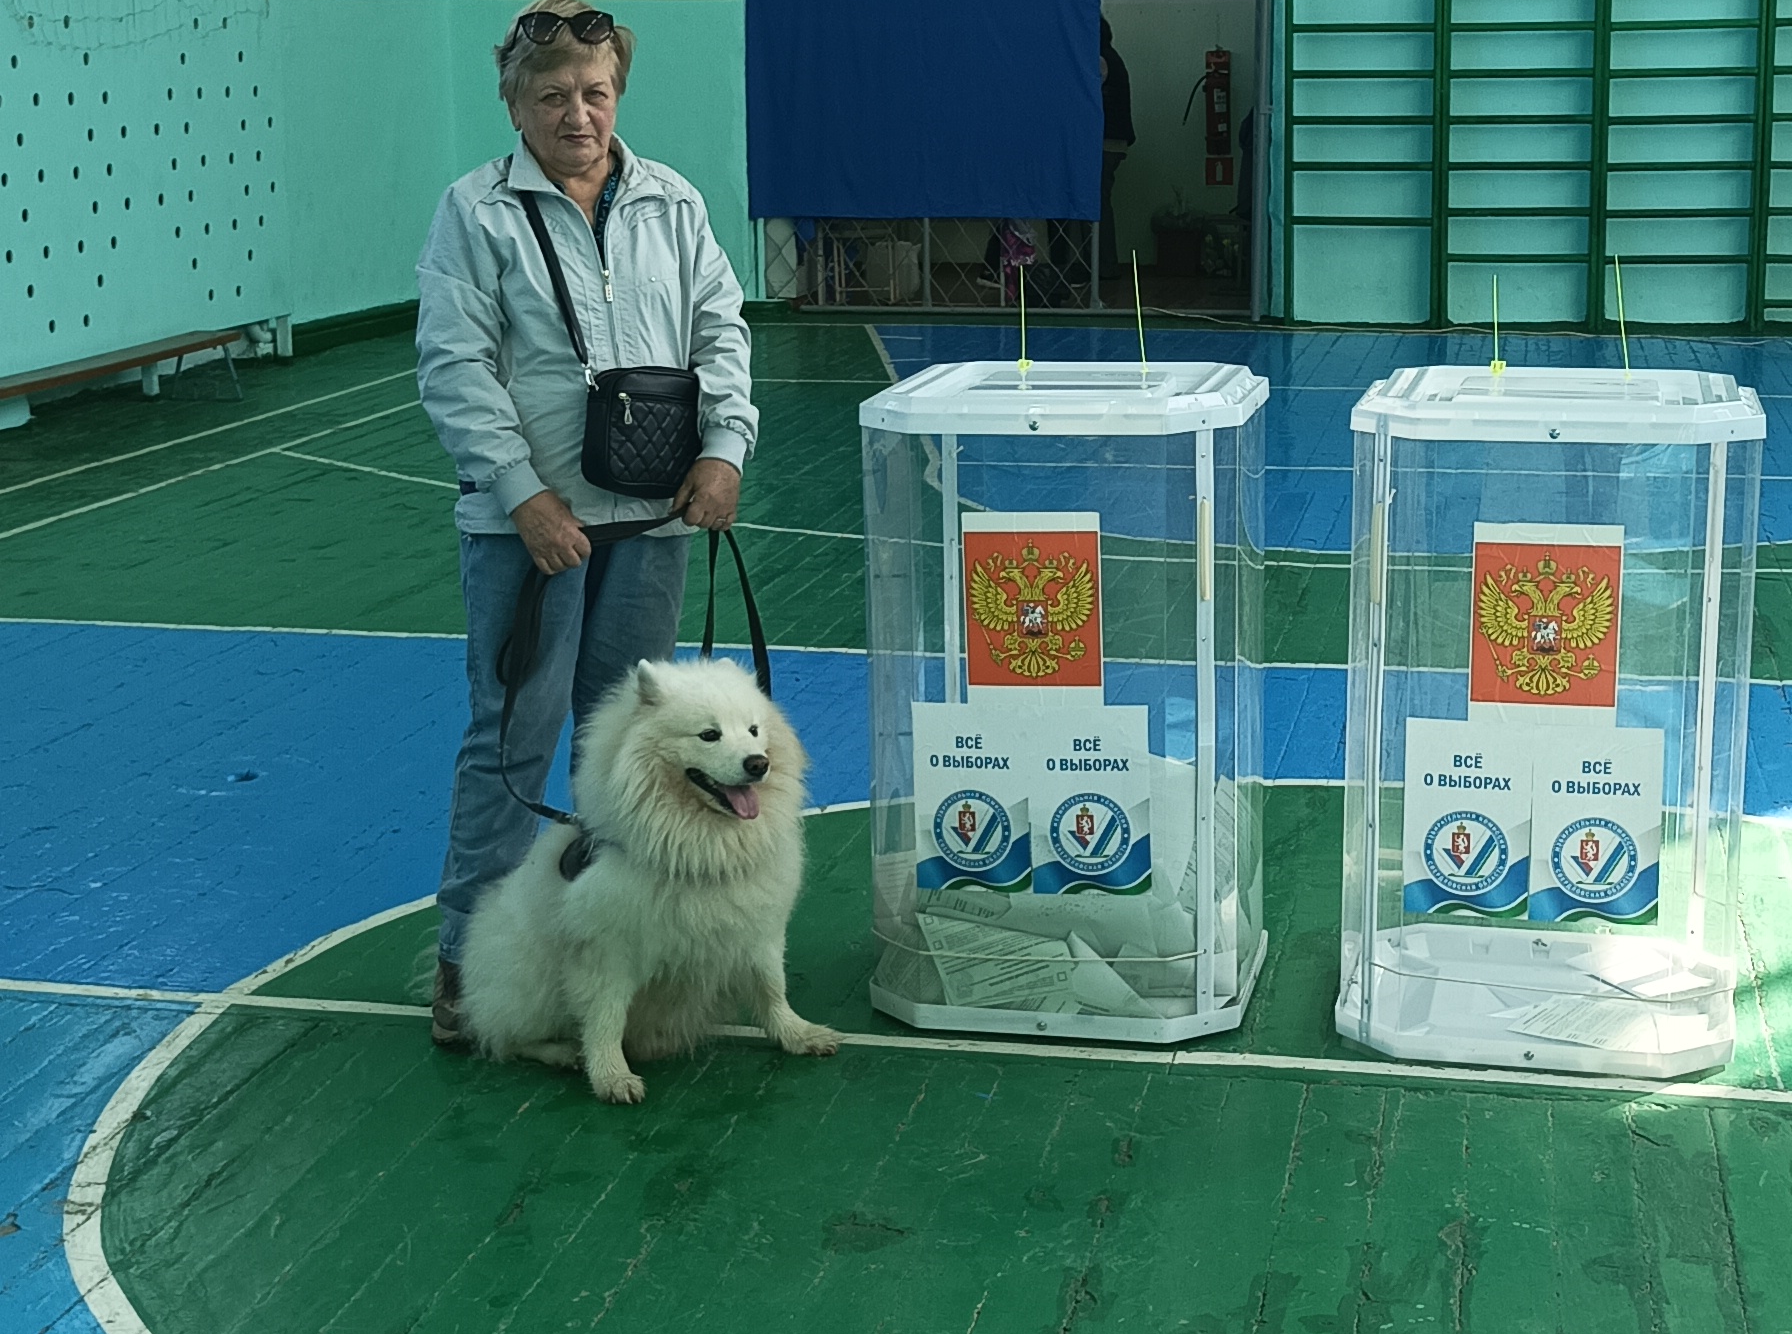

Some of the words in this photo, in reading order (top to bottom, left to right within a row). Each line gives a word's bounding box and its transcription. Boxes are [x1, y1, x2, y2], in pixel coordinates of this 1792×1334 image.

[955, 733, 983, 749] ВСЁ
[1073, 736, 1101, 752] ВСЁ
[930, 755, 939, 768] О
[942, 755, 1010, 770] ВЫБОРАХ
[1046, 758, 1056, 771] О
[1059, 758, 1130, 772] ВЫБОРАХ
[1453, 752, 1483, 769] ВСЁ
[1581, 758, 1612, 775] ВСЁ
[1423, 773, 1433, 786] О
[1437, 774, 1512, 791] ВЫБОРАХ
[1551, 780, 1562, 793] О
[1566, 780, 1641, 796] ВЫБОРАХ
